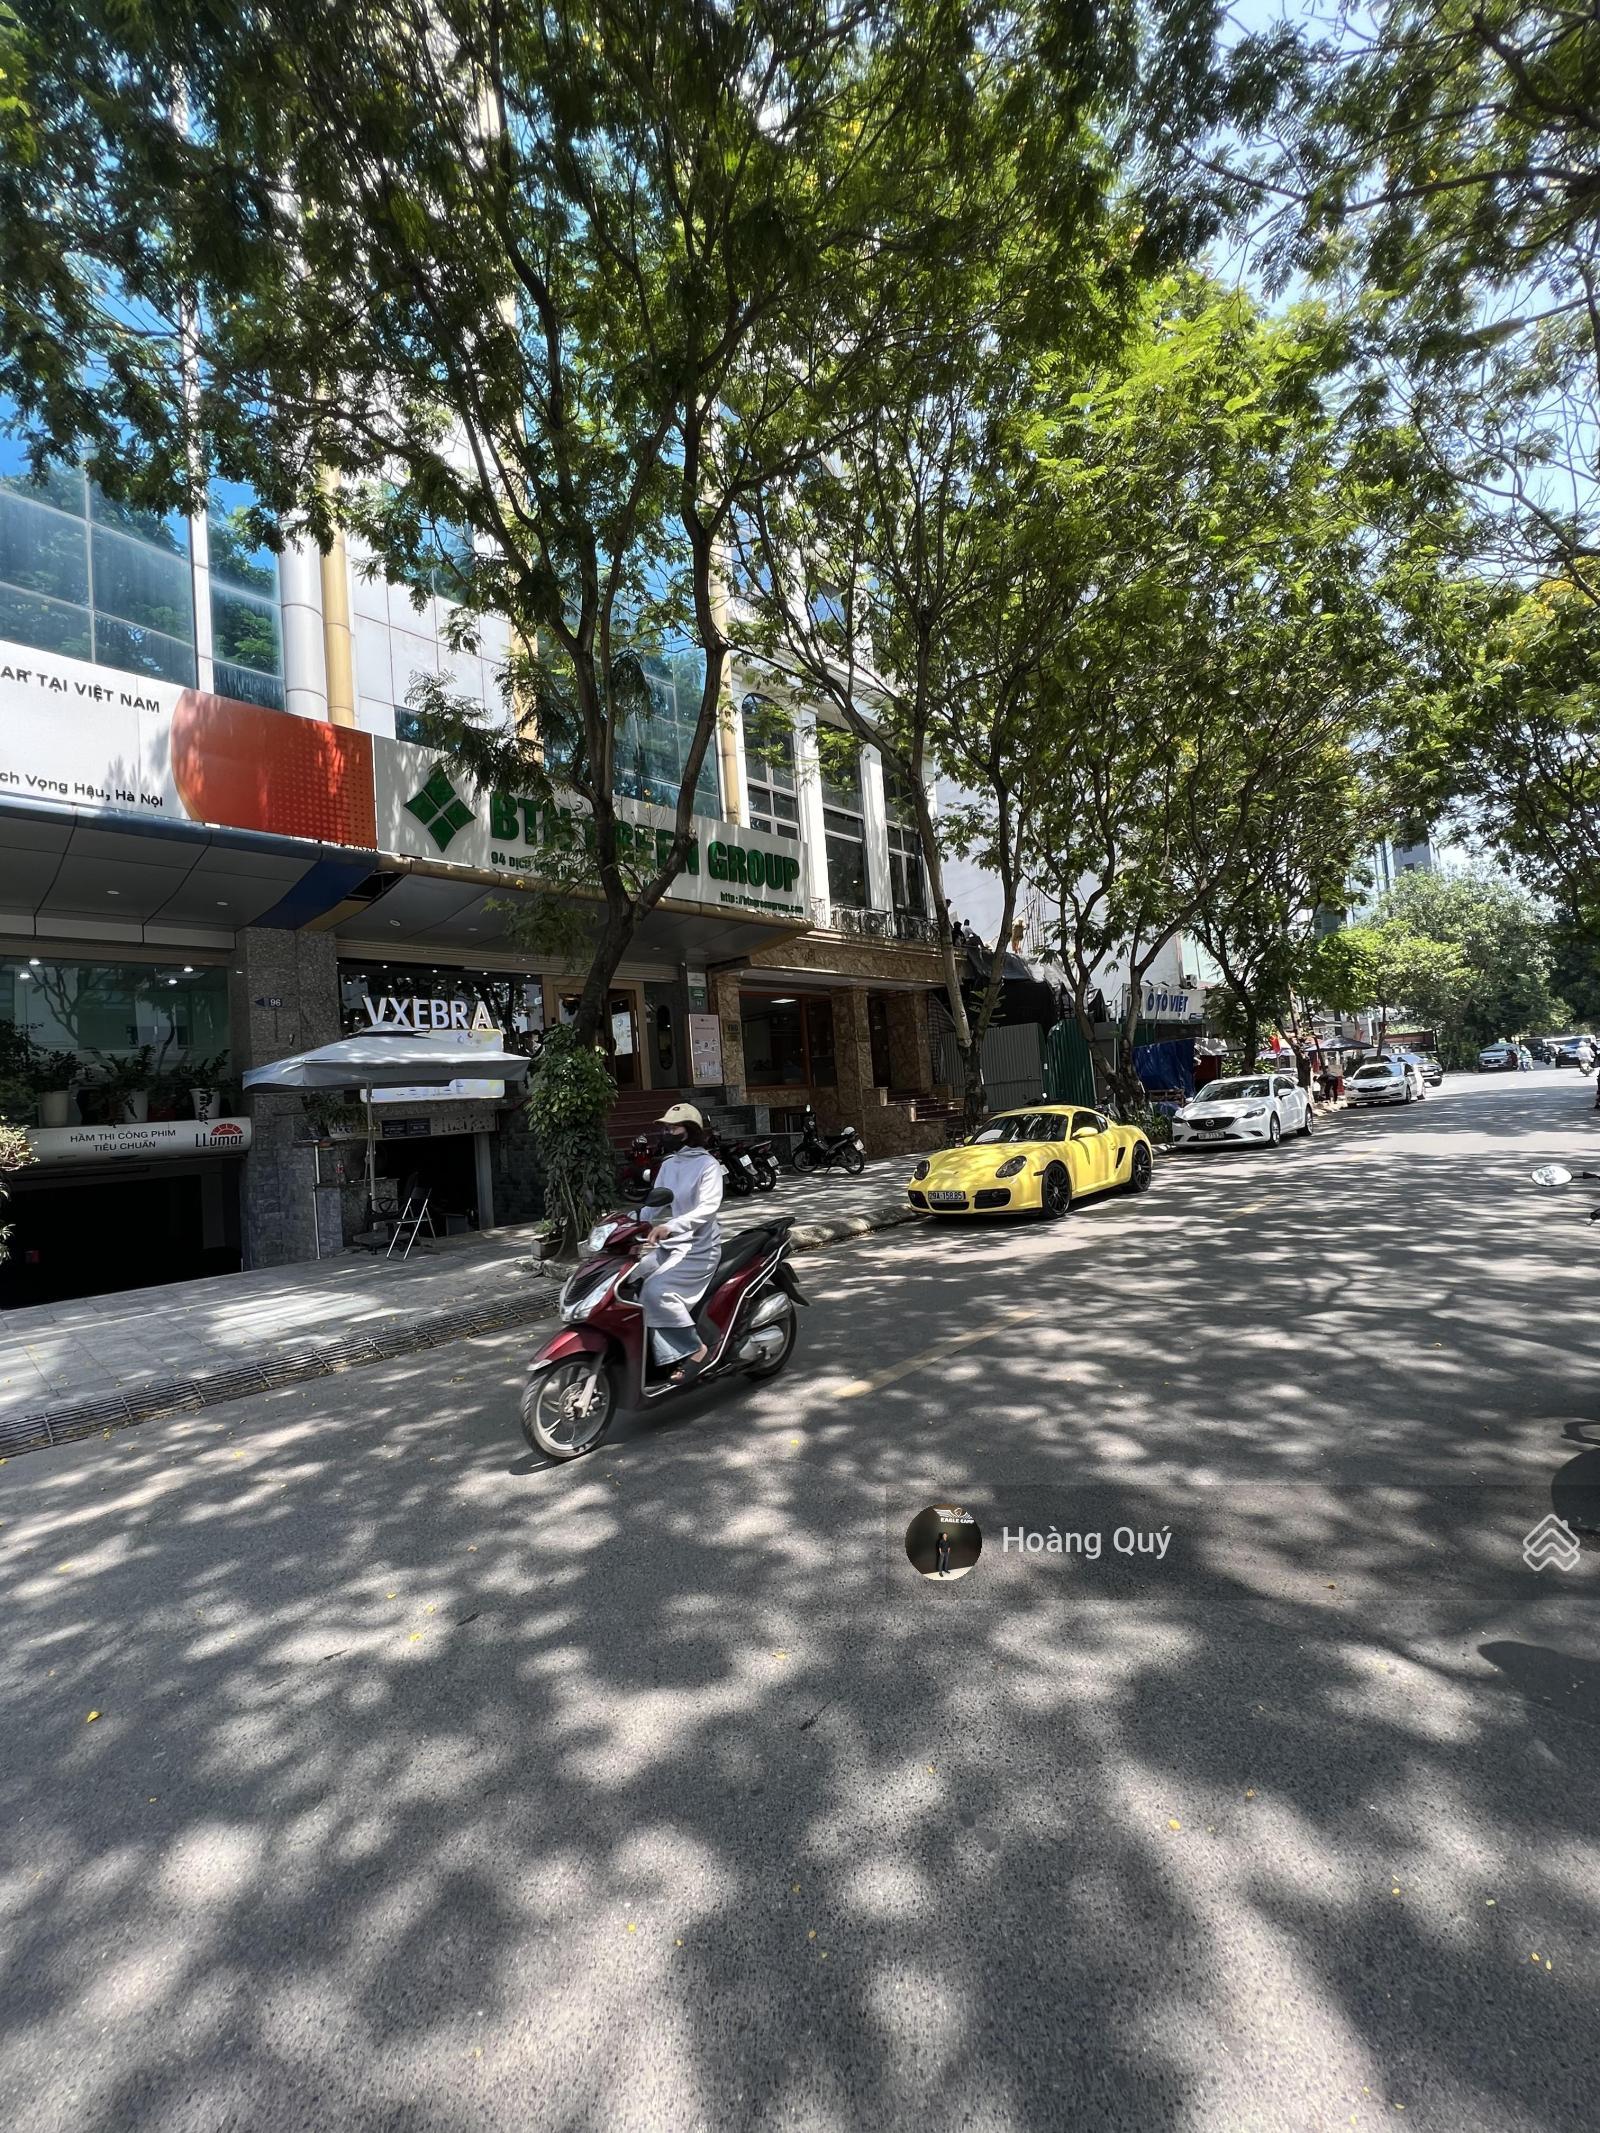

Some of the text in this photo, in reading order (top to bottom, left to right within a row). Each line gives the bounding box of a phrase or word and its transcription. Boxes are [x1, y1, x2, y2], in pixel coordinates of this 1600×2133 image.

[36, 673, 67, 692] TẠI
[74, 682, 114, 702] VIỆT
[120, 692, 160, 713] NAM
[25, 774, 68, 794] Vọng
[116, 789, 136, 802] Hà
[140, 793, 163, 808] Nội
[491, 851, 506, 866] 94
[707, 840, 800, 893] GROUP
[362, 997, 494, 1031] VXEBRA
[93, 1141, 118, 1152] TIÊU
[98, 1132, 116, 1141] THI
[118, 1129, 148, 1140] CÔNG
[151, 1129, 177, 1138] PHIM
[195, 1133, 244, 1147] LLumar
